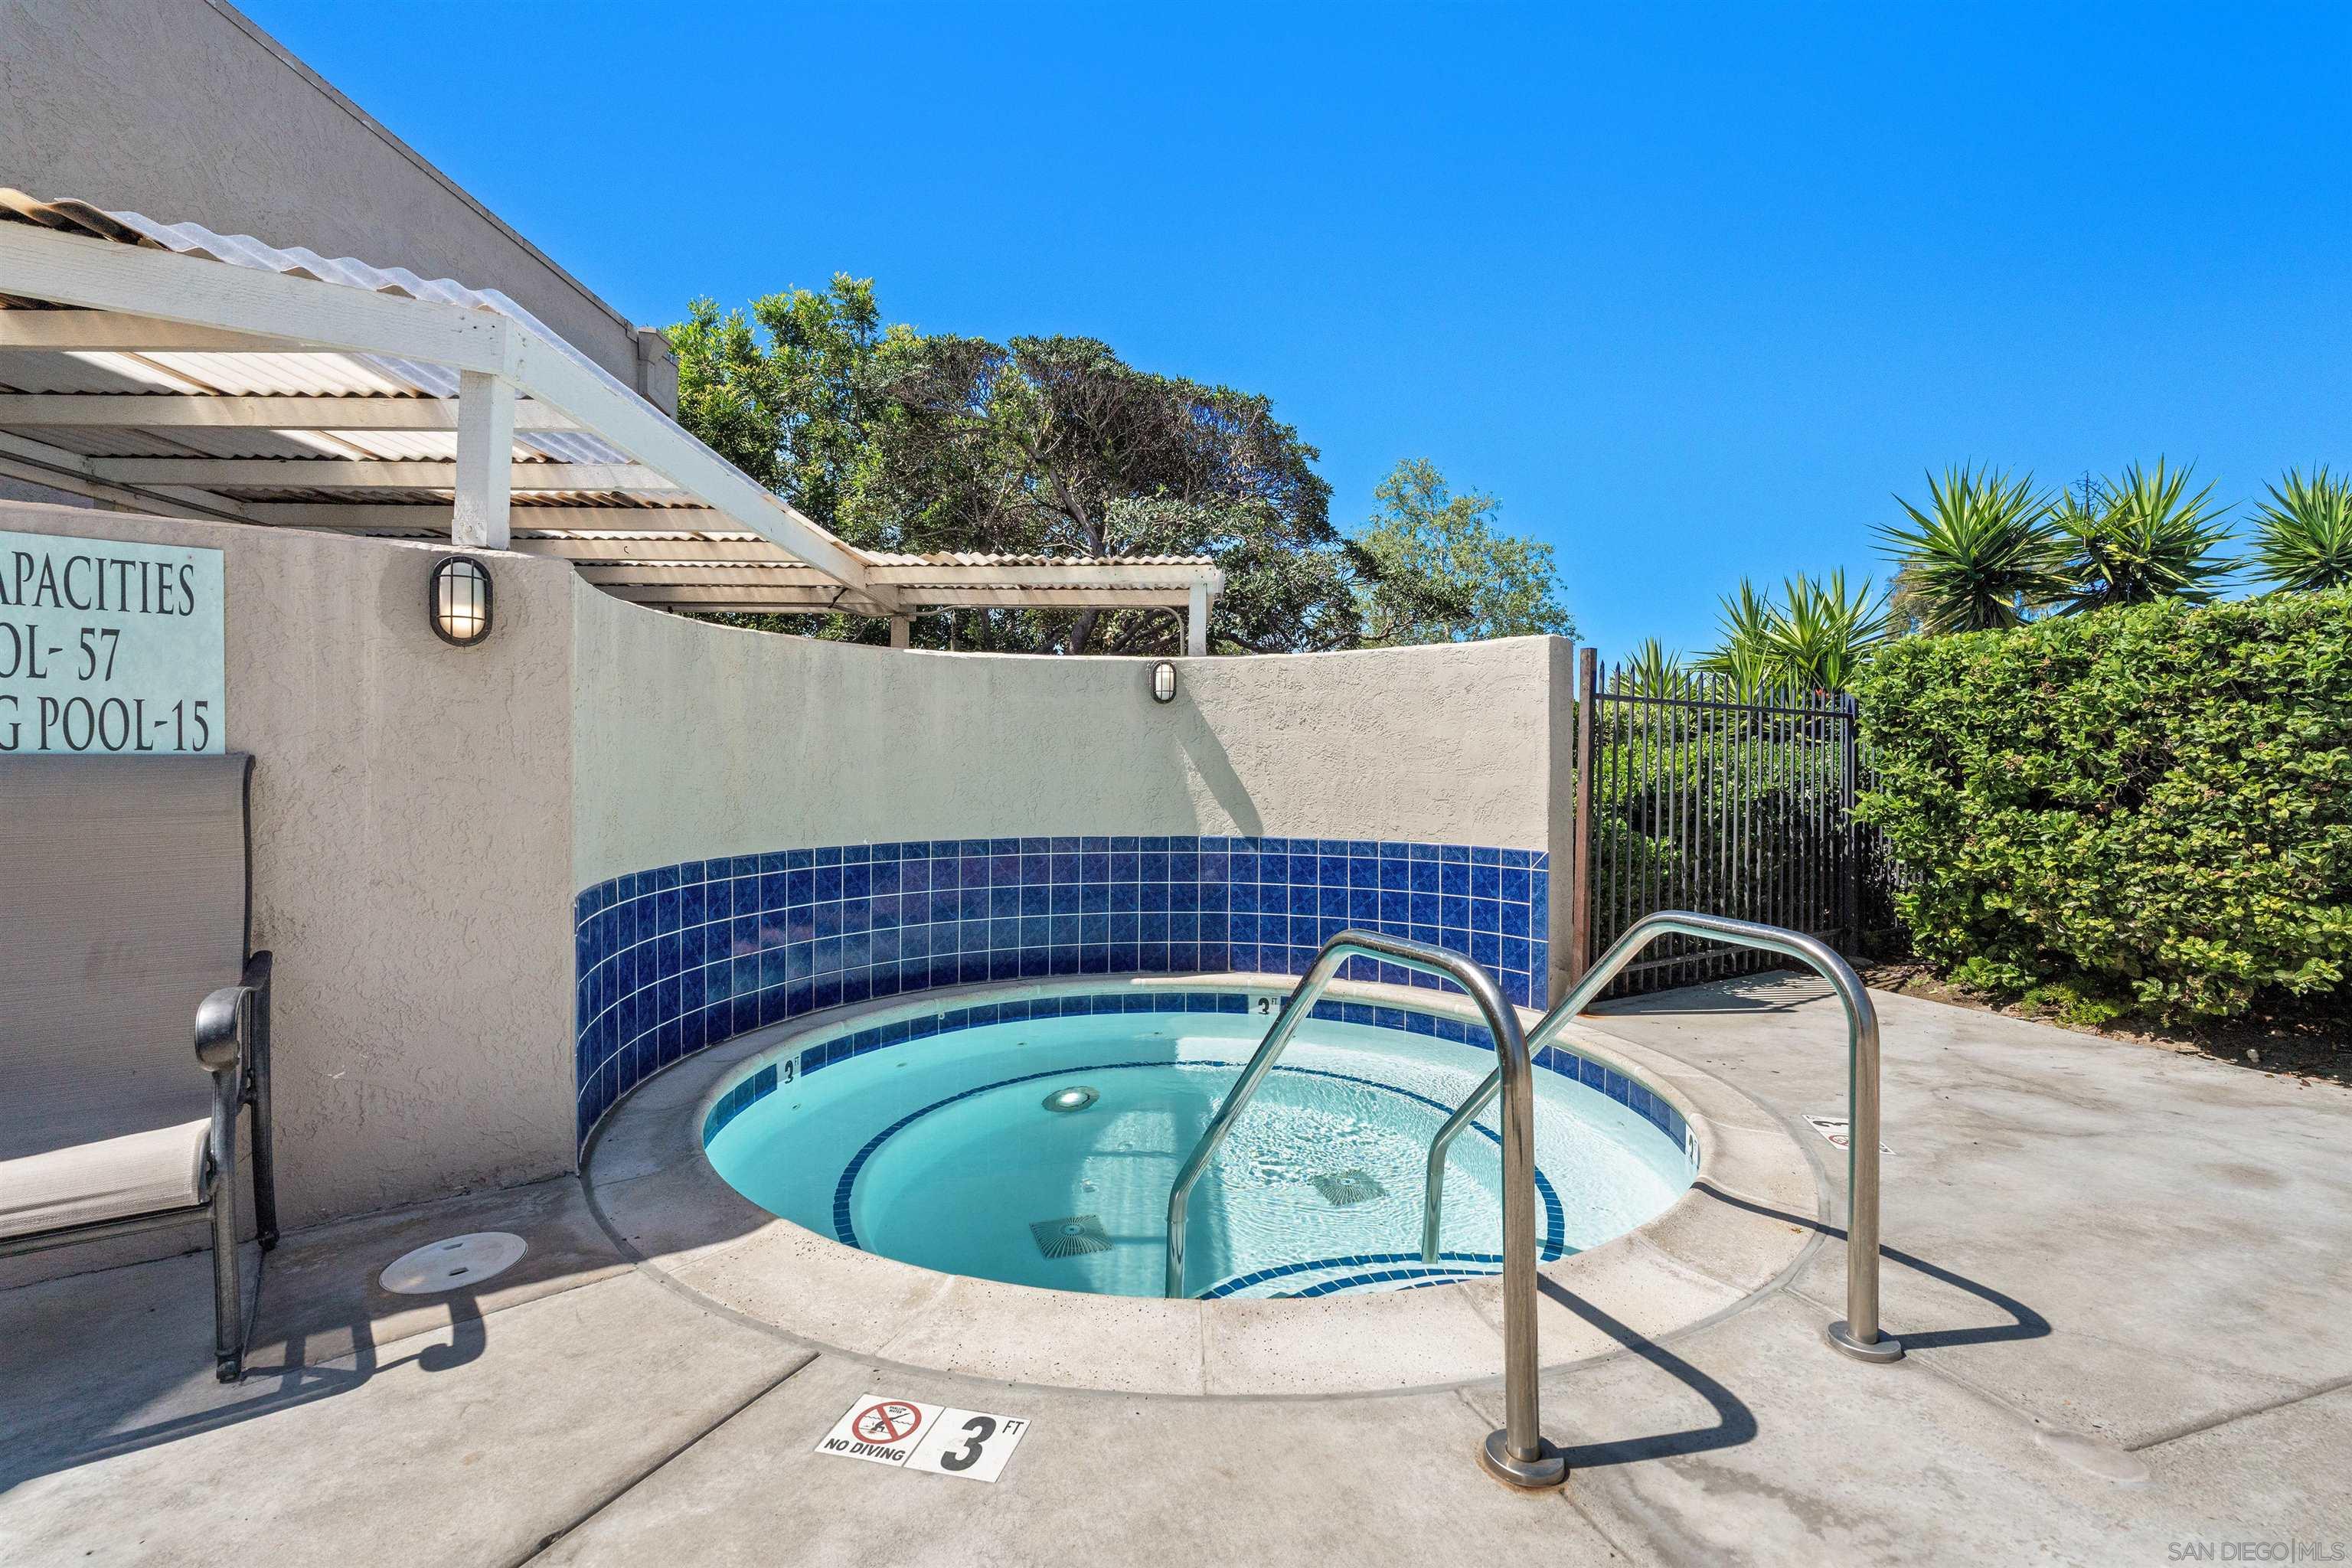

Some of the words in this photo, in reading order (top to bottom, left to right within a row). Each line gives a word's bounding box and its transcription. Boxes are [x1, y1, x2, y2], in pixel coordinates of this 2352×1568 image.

[78, 628, 120, 681] 57
[37, 696, 209, 752] POOL-15
[824, 1438, 850, 1452] NO
[849, 1442, 905, 1462] DIVING
[940, 1416, 997, 1472] 3
[1002, 1420, 1024, 1436] FT
